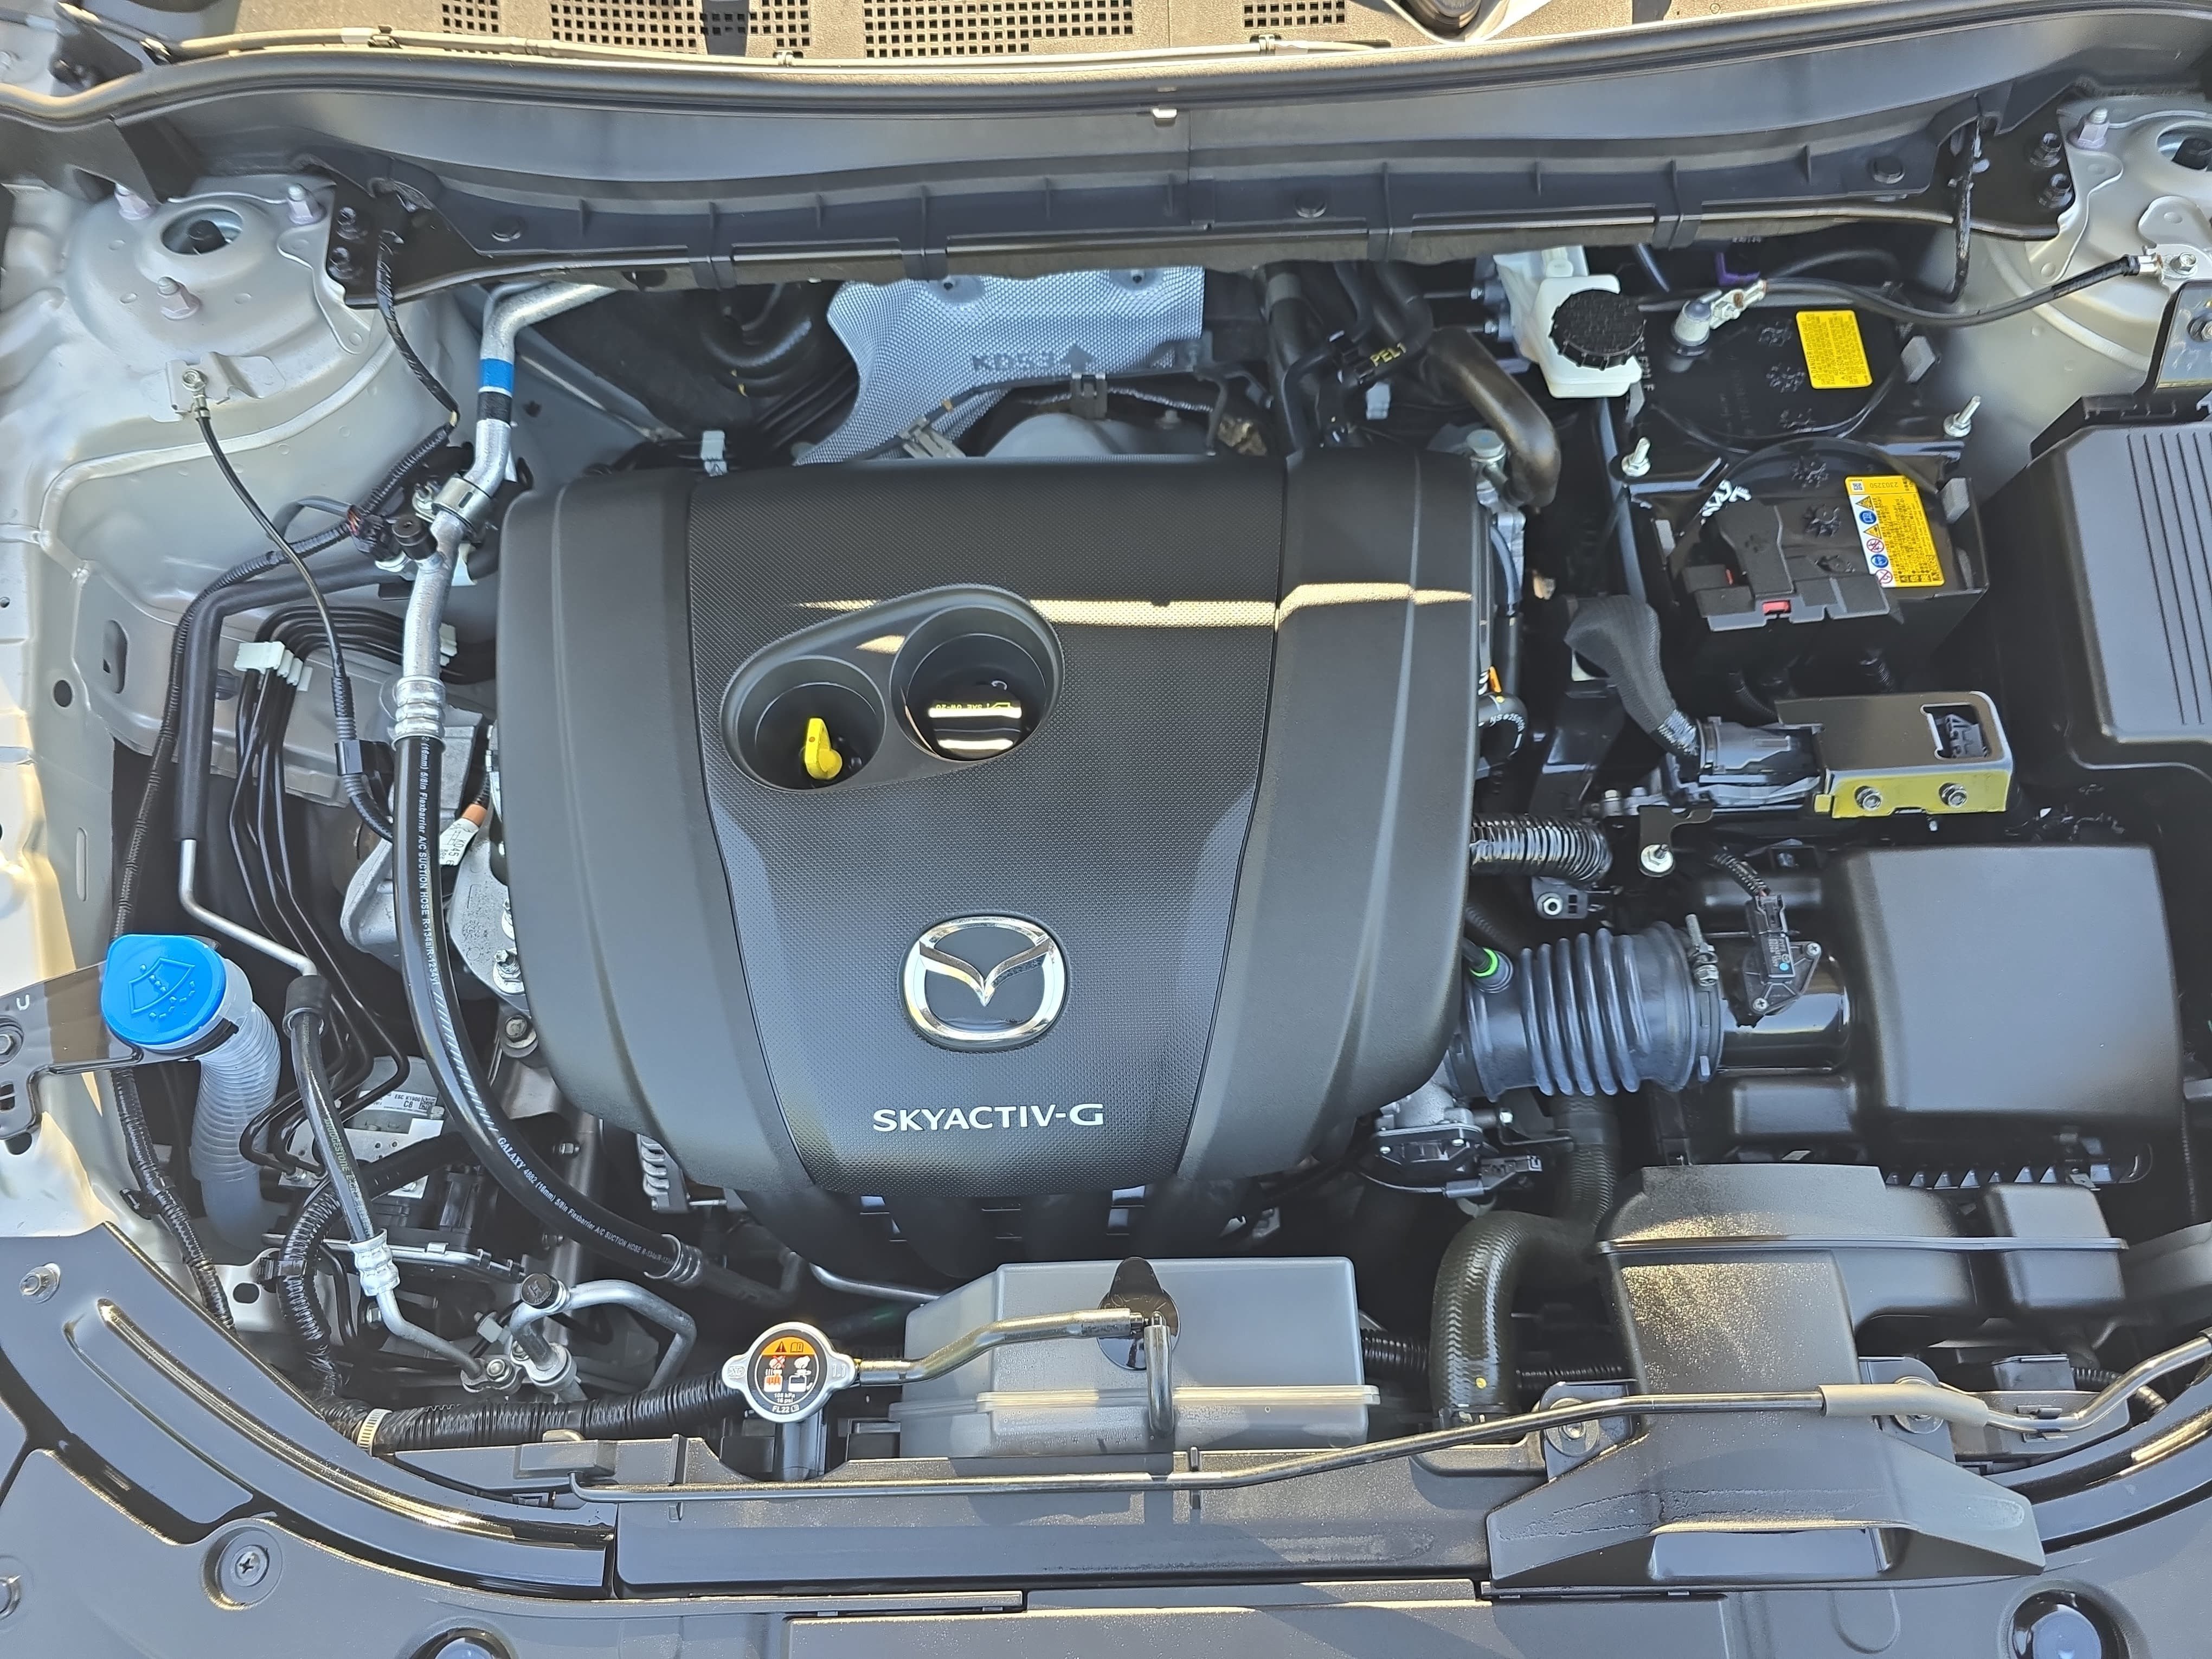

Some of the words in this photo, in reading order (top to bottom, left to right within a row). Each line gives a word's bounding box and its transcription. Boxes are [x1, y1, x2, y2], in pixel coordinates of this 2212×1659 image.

[418, 835, 427, 850] A/C
[418, 852, 428, 890] SUCTION
[420, 891, 429, 915] HOSE
[873, 1103, 1104, 1131] SKYACTIV-G
[498, 1136, 526, 1169] GALAXY
[605, 1231, 626, 1247] SUCTION
